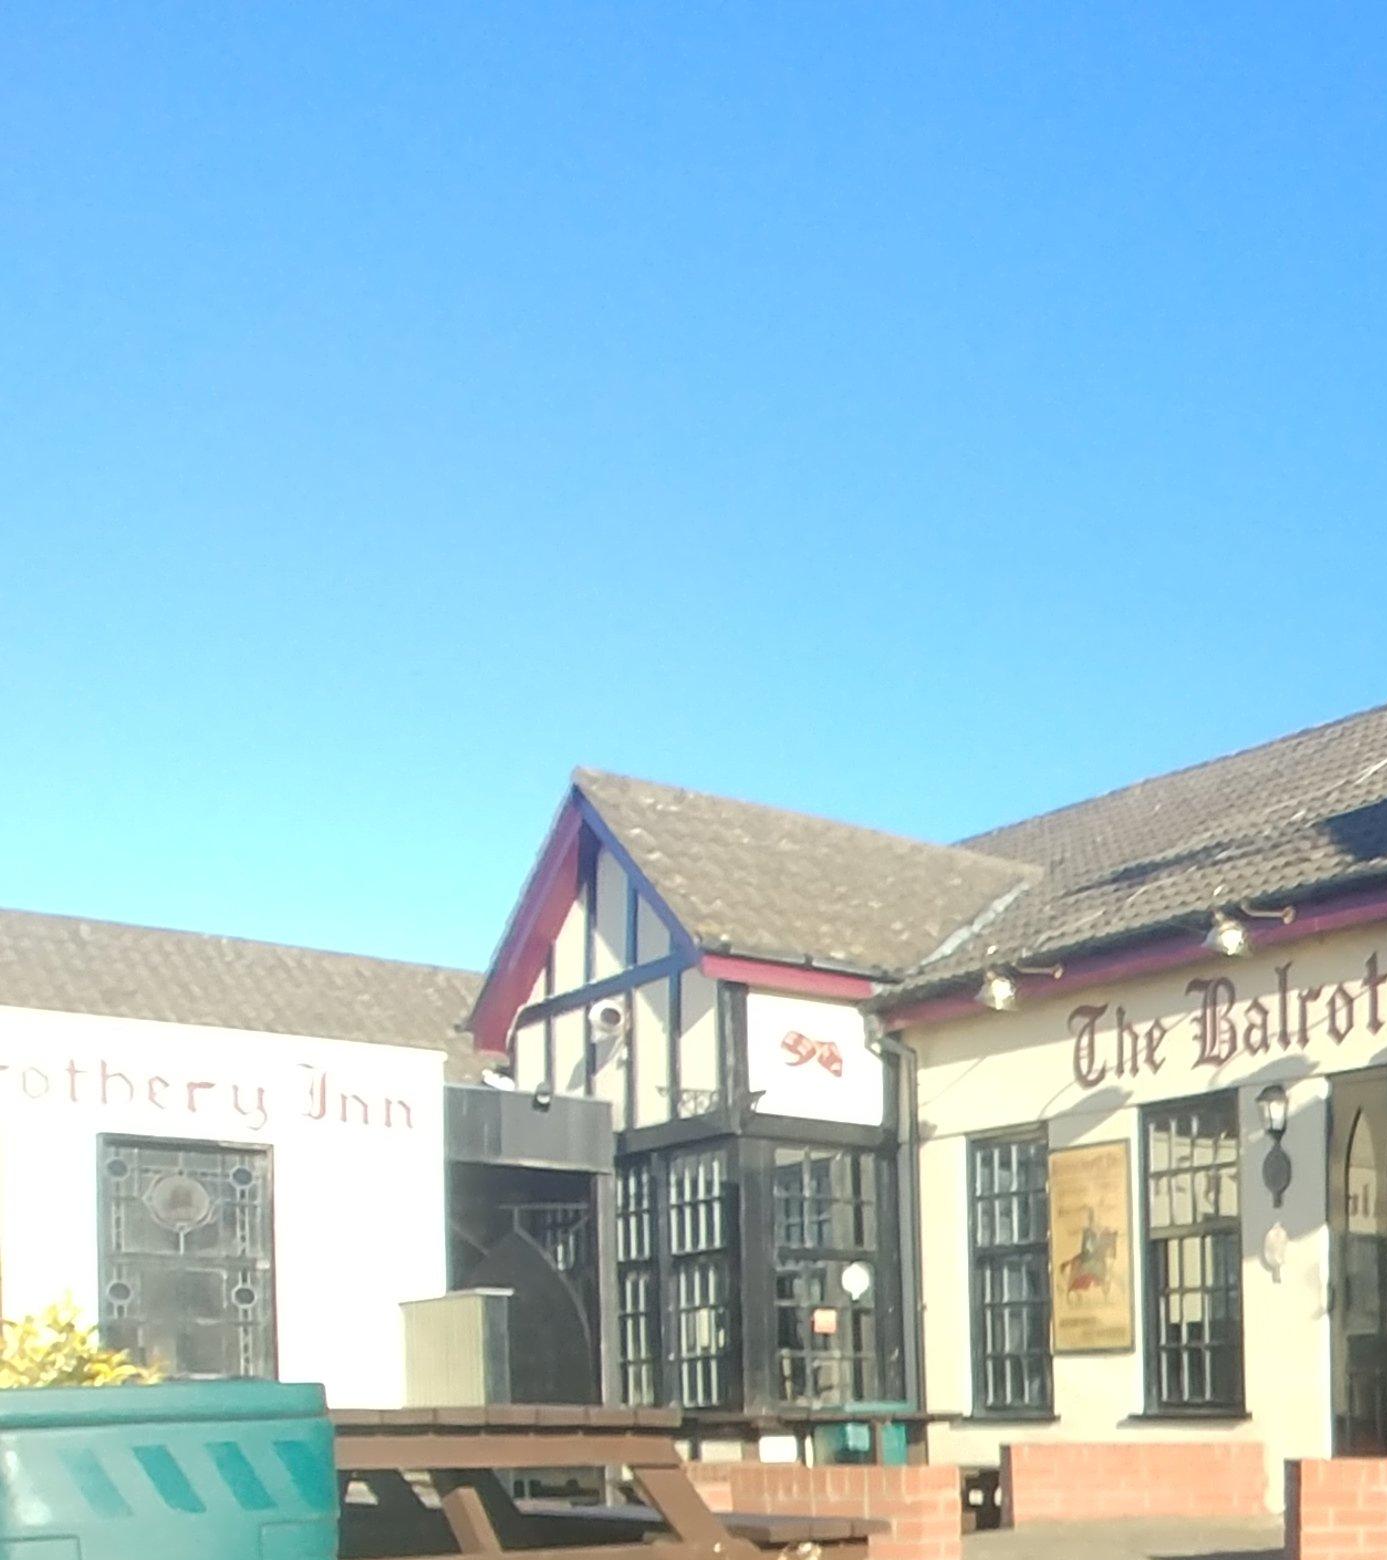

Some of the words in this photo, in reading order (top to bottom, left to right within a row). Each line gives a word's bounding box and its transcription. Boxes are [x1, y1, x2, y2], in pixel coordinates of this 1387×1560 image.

[1067, 1003, 1166, 1089] The
[0, 1058, 268, 1131] othery
[298, 1062, 413, 1129] Inn
